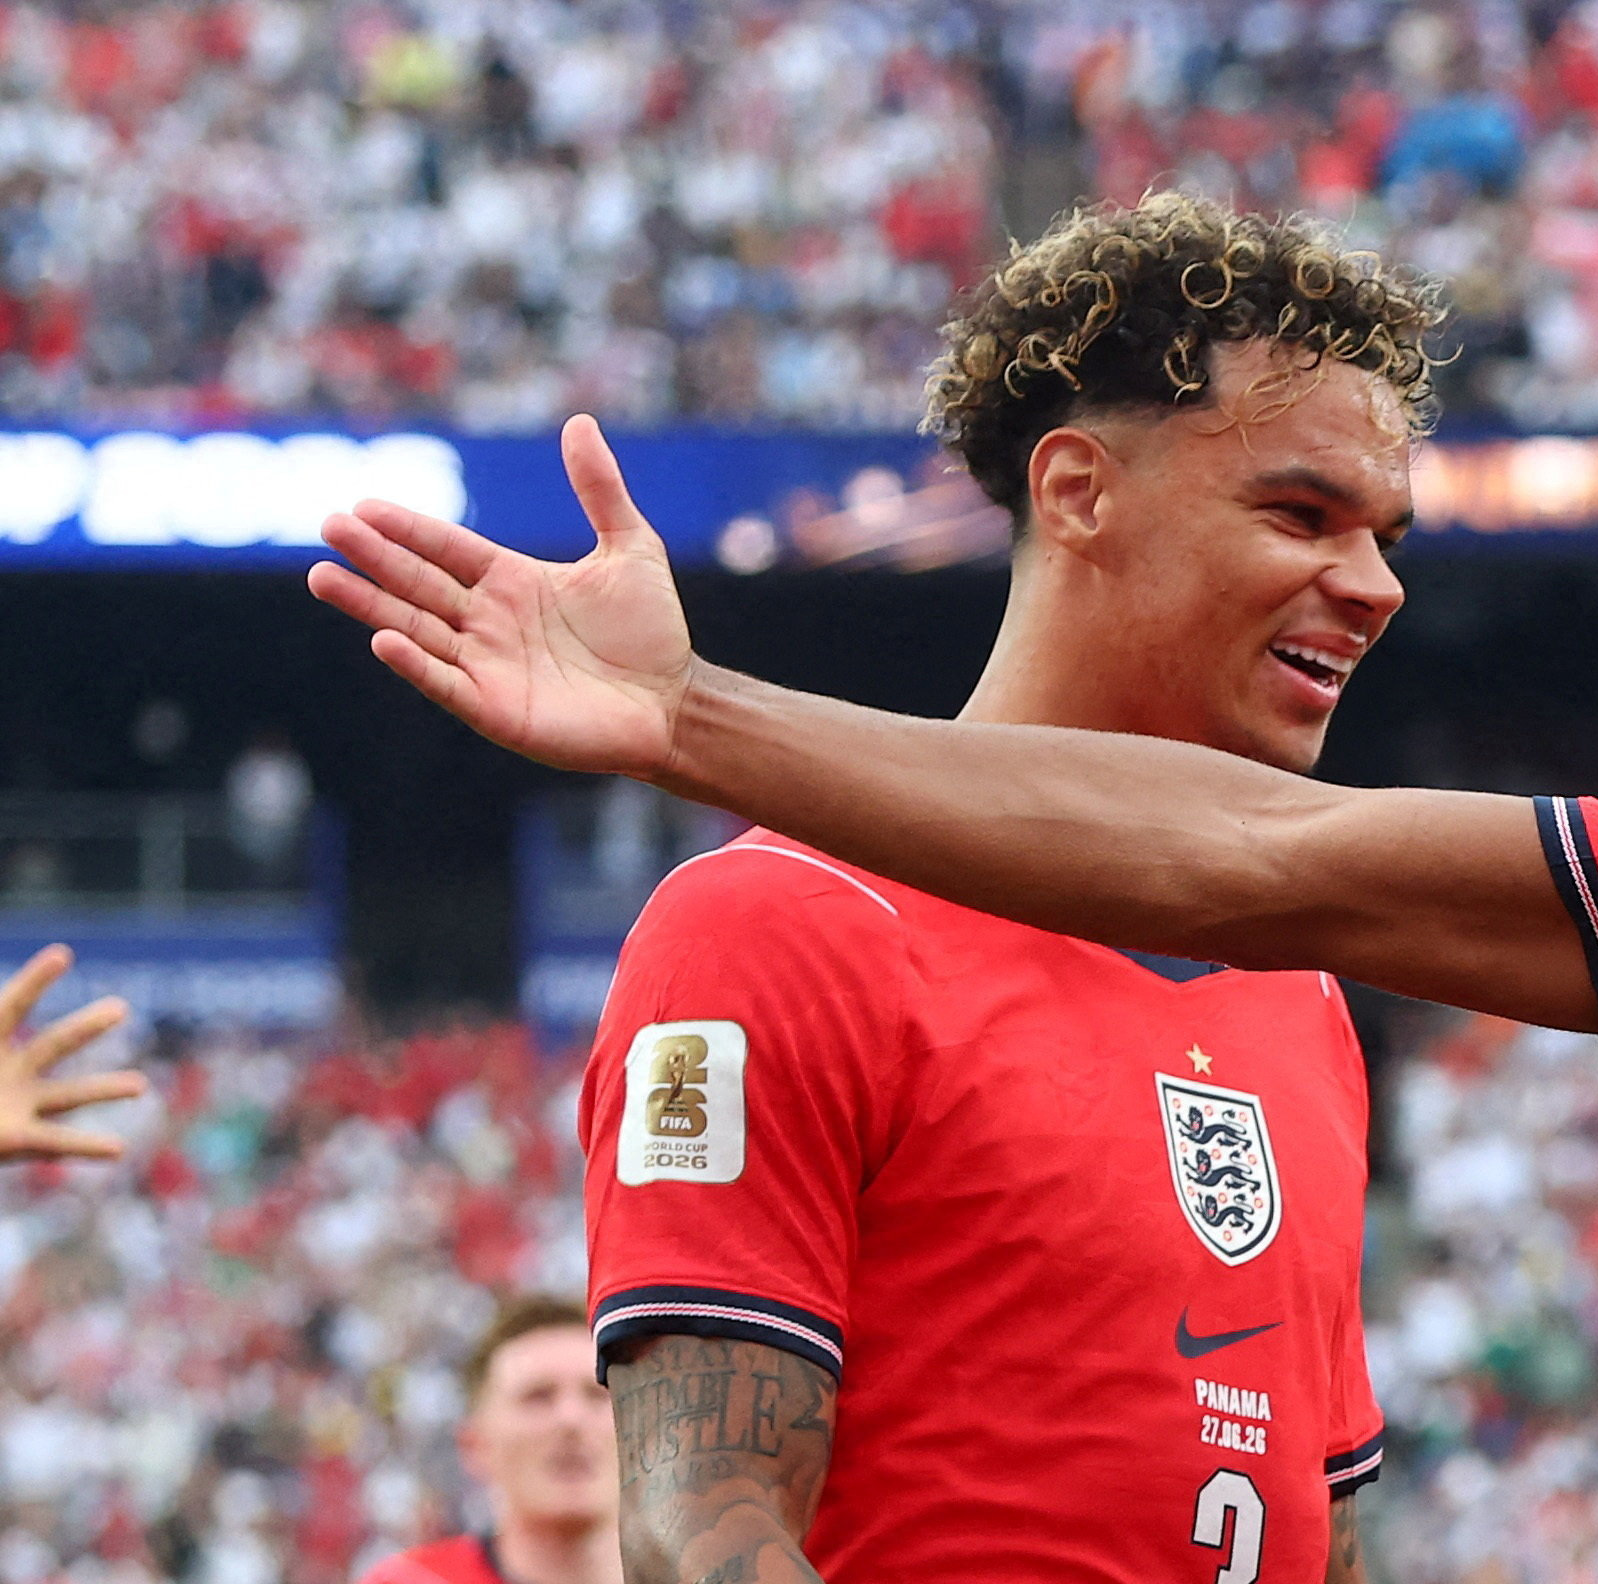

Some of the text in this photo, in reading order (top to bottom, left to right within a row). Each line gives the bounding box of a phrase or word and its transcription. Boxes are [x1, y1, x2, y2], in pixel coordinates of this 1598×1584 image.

[660, 1115, 692, 1130] FIFA
[685, 1142, 709, 1153] CUP
[643, 1153, 708, 1170] 2026
[1194, 1378, 1272, 1421] PANAMA
[1200, 1414, 1266, 1455] 27.06.26
